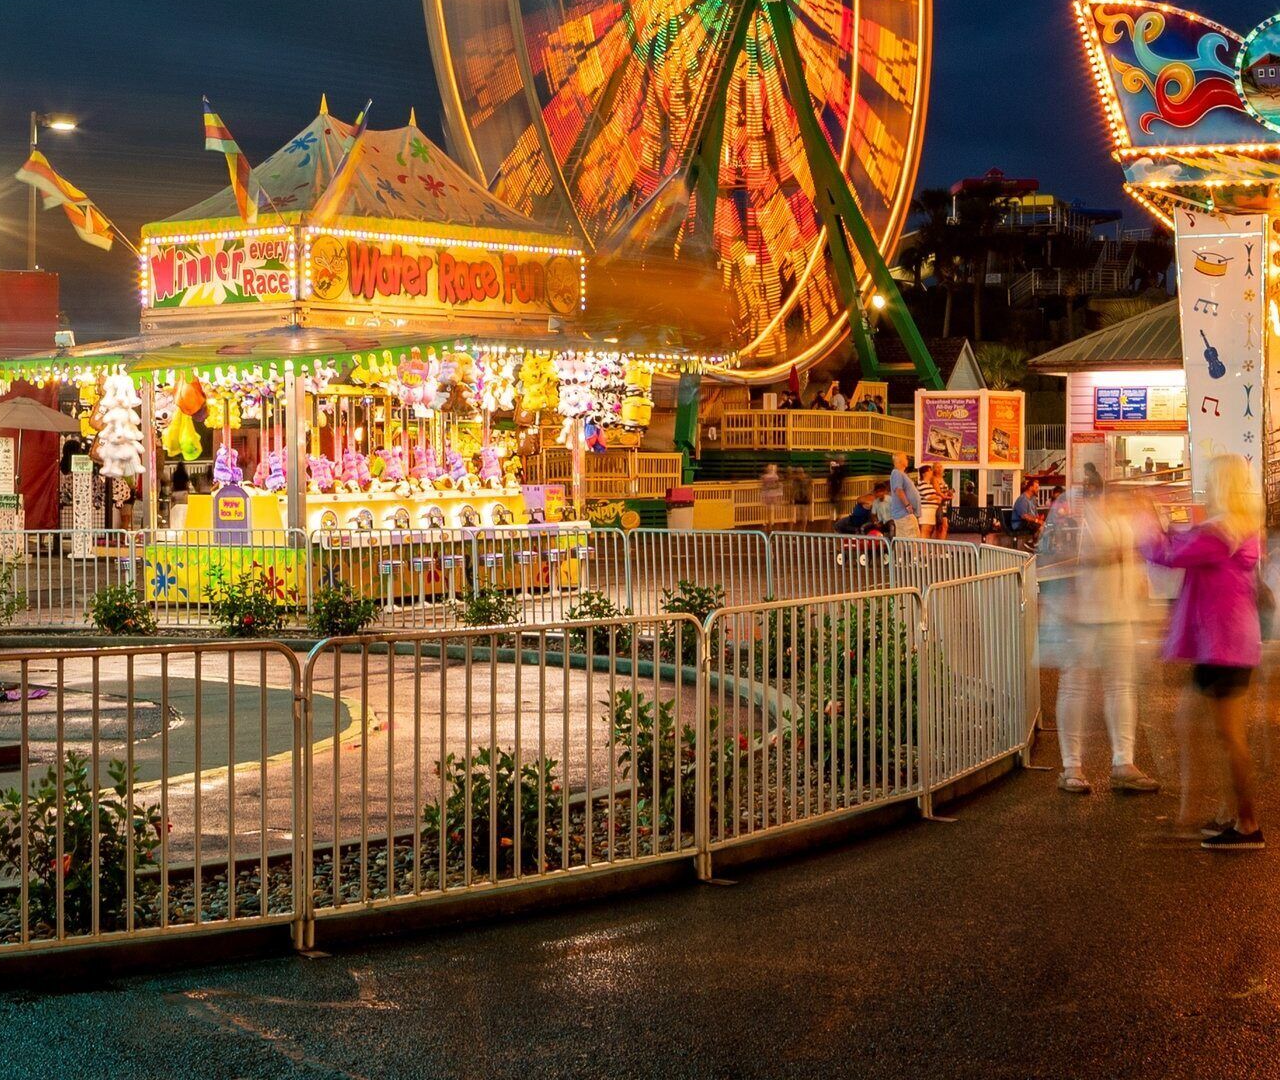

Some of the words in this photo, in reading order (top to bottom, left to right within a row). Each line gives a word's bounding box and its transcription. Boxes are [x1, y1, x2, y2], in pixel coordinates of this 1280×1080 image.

[249, 240, 289, 262] every
[151, 247, 245, 302] Winner
[242, 269, 290, 296] Race
[347, 240, 432, 299] Water
[437, 253, 500, 304] Race
[502, 253, 546, 304] Fun
